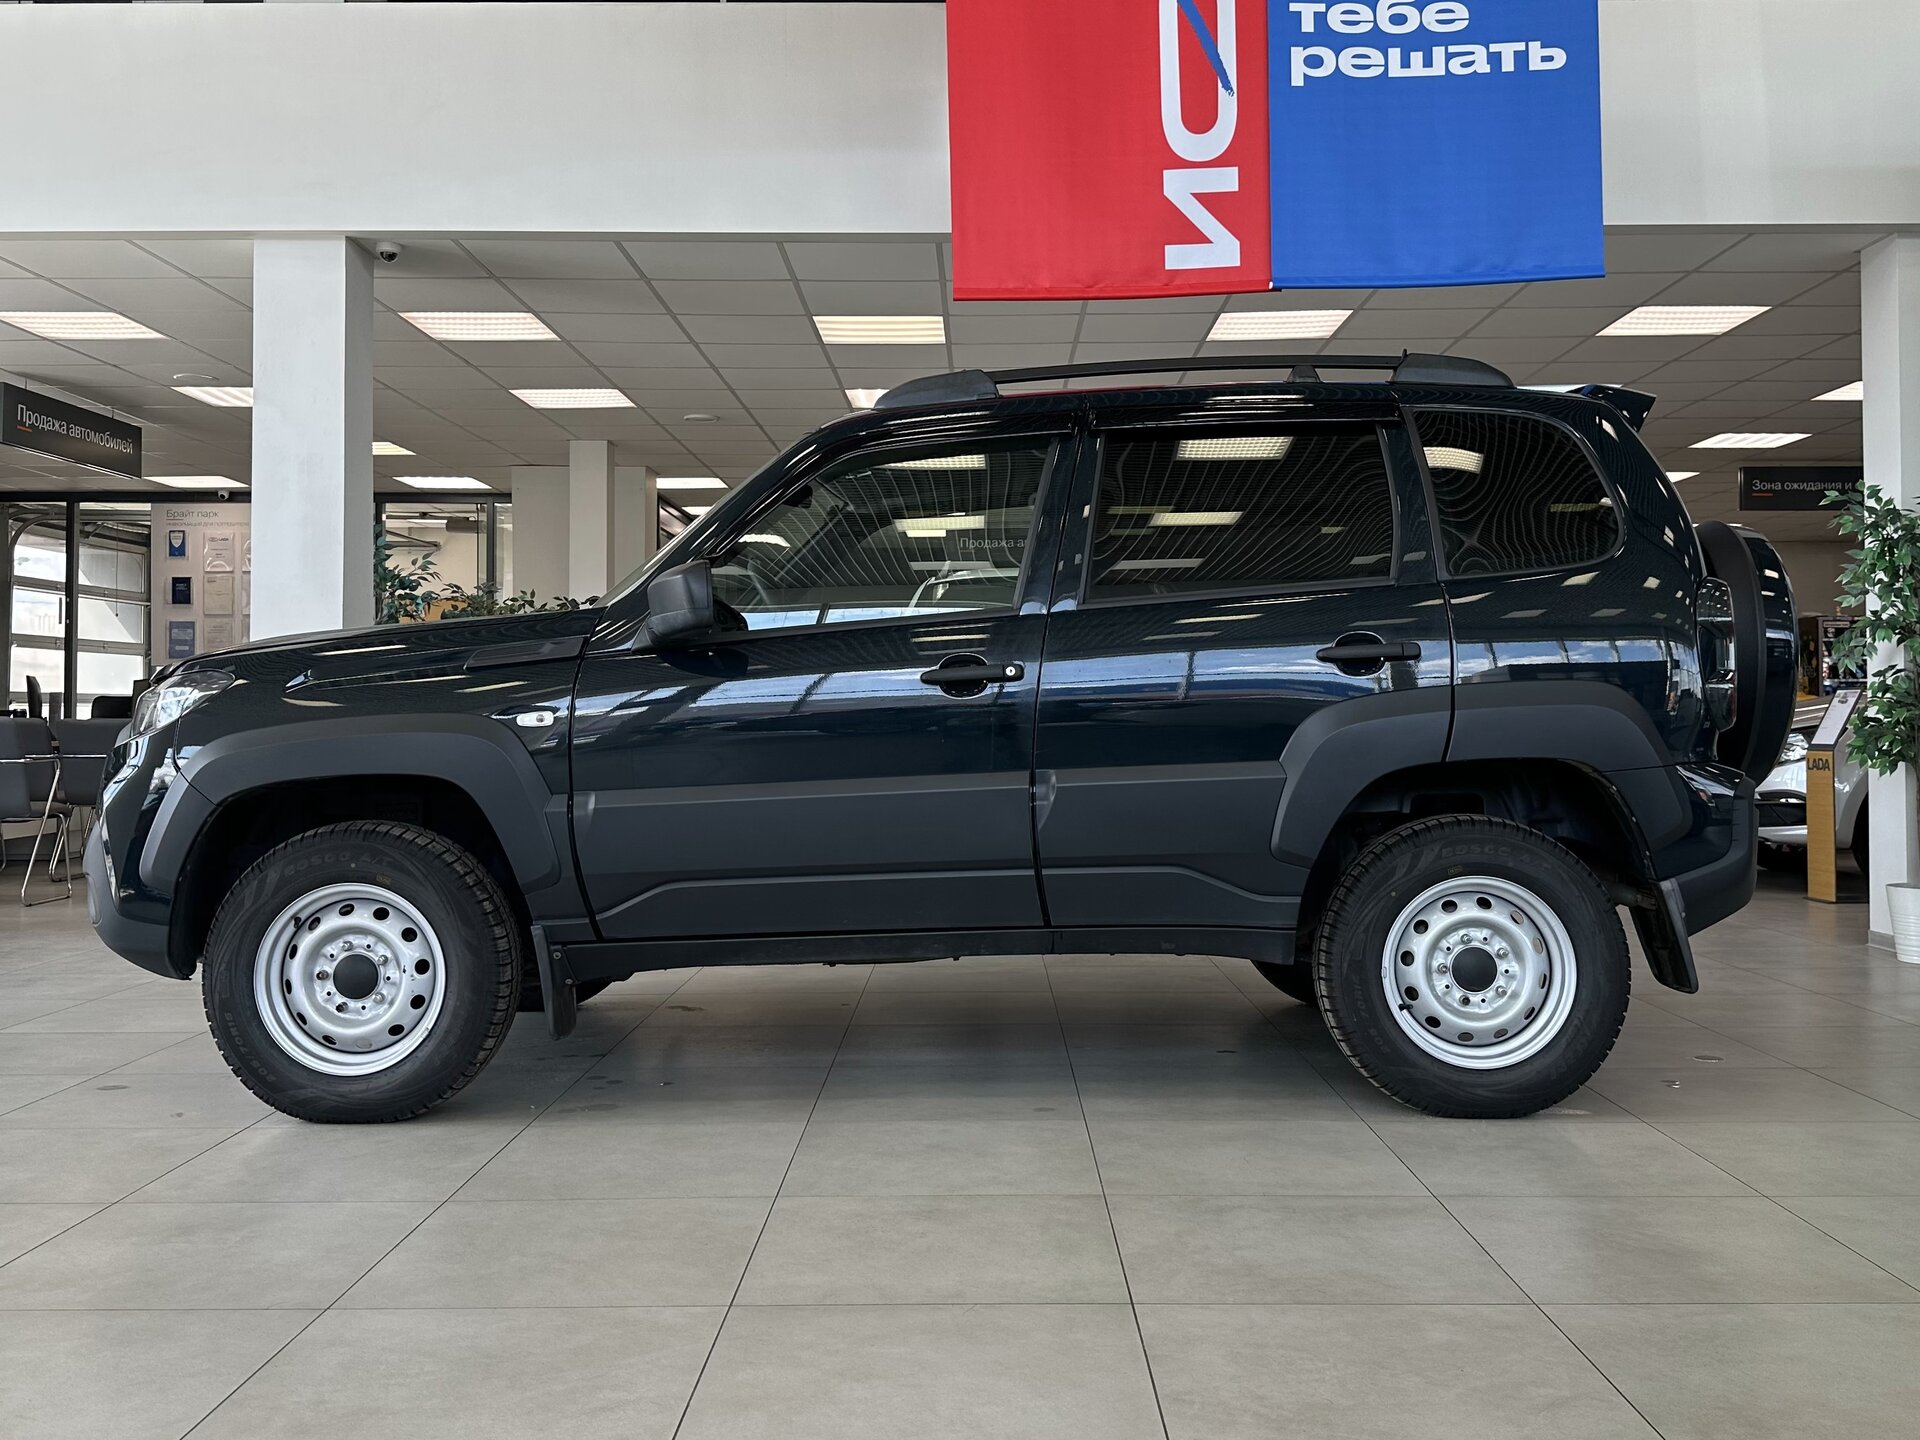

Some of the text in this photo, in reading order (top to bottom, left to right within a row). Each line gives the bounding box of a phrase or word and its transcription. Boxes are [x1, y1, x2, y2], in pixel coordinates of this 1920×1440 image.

[1289, 0, 1469, 34] тебе
[1290, 41, 1567, 87] решать
[17, 403, 133, 454] Продажа автомобилей
[1752, 479, 1852, 491] Зона ожидания и
[166, 509, 194, 518] Брайт
[960, 537, 1014, 550] Продажа
[1807, 757, 1831, 772] LADA
